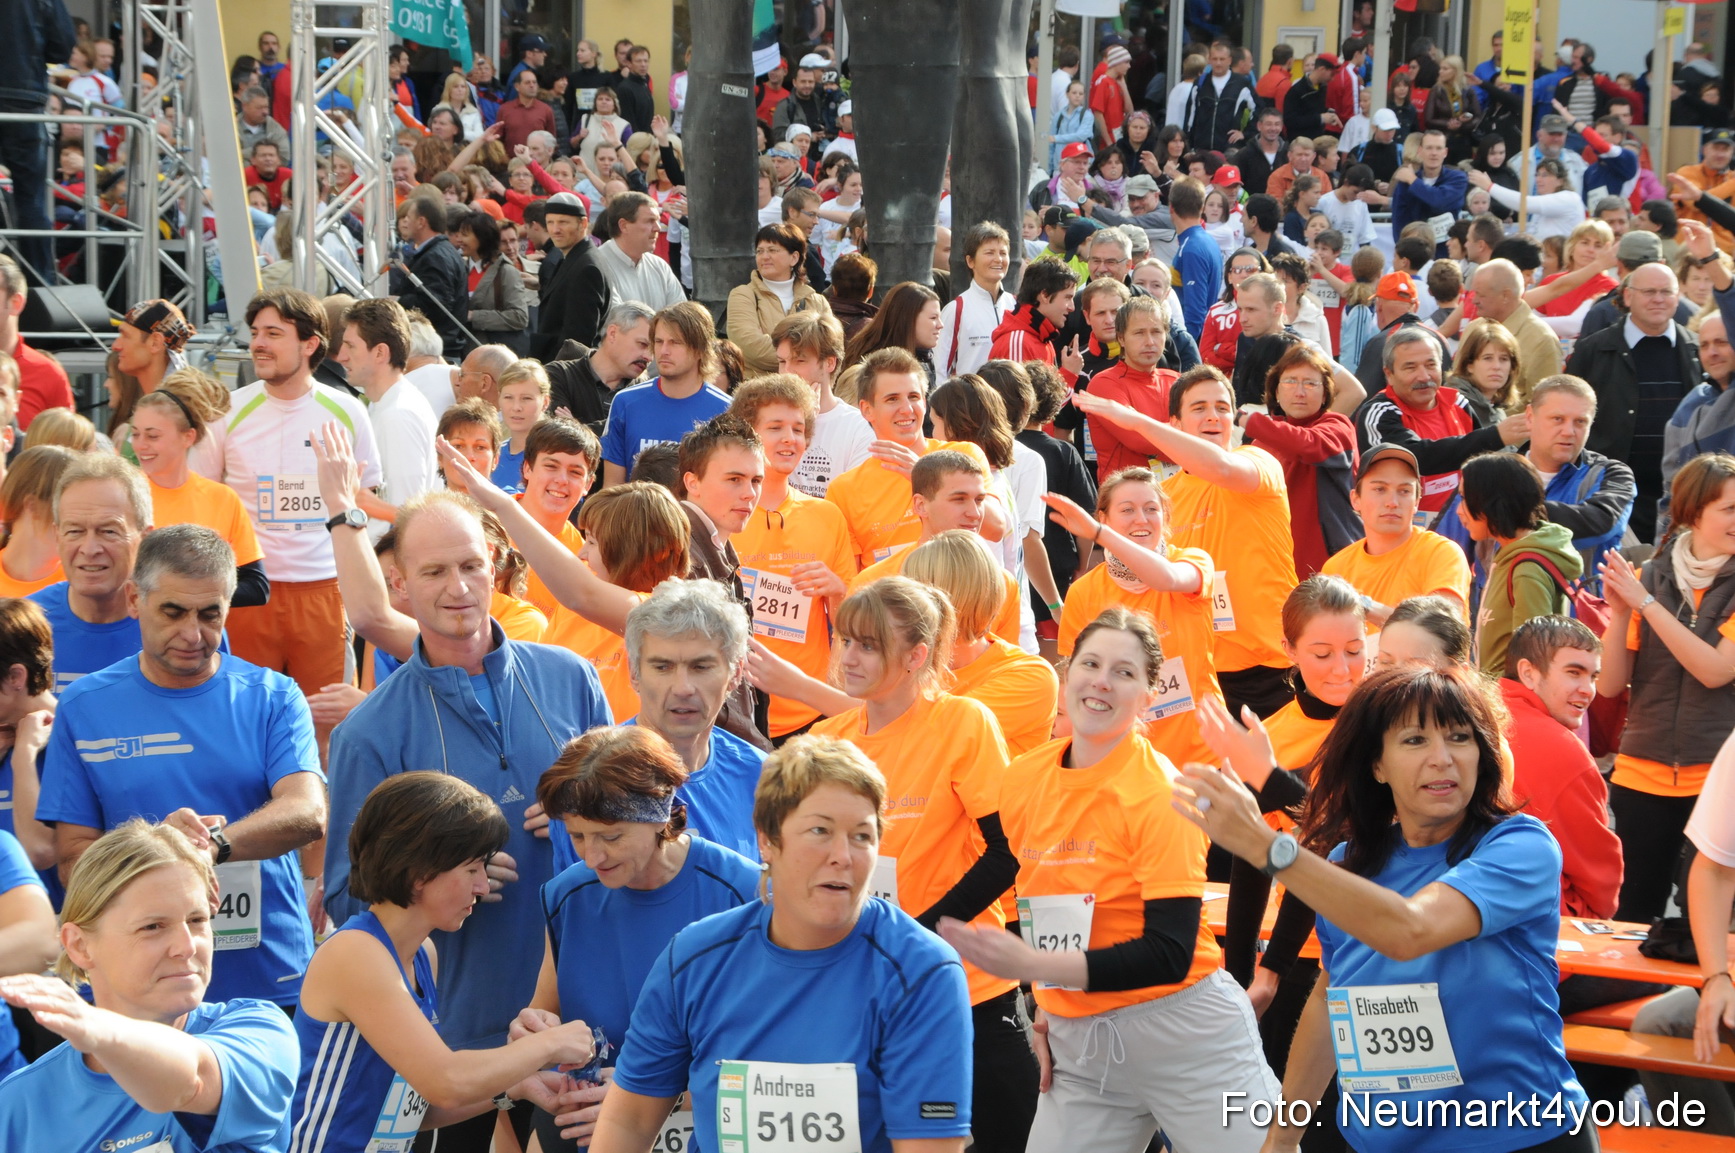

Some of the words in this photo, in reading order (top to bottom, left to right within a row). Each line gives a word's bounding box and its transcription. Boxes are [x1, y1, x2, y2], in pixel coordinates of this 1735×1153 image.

[1505, 8, 1532, 26] Jugend-
[1511, 28, 1525, 43] lauf
[1216, 313, 1237, 330] 10
[278, 479, 305, 491] Bernd
[280, 496, 322, 512] 2805
[768, 550, 817, 562] ausbildung
[759, 577, 793, 595] Markus
[756, 595, 800, 620] 2811
[1163, 700, 1194, 714] PFLEIDERER
[500, 794, 525, 804] adidas
[211, 892, 251, 919] 40
[217, 934, 258, 945] PFLEIDERER
[1355, 995, 1419, 1016] Elisabeth
[1363, 1025, 1434, 1055] 3399
[753, 1073, 815, 1098] Andrea
[1409, 1072, 1457, 1084] PFLEIDERER
[722, 1106, 731, 1123] S
[757, 1111, 845, 1143] 5163
